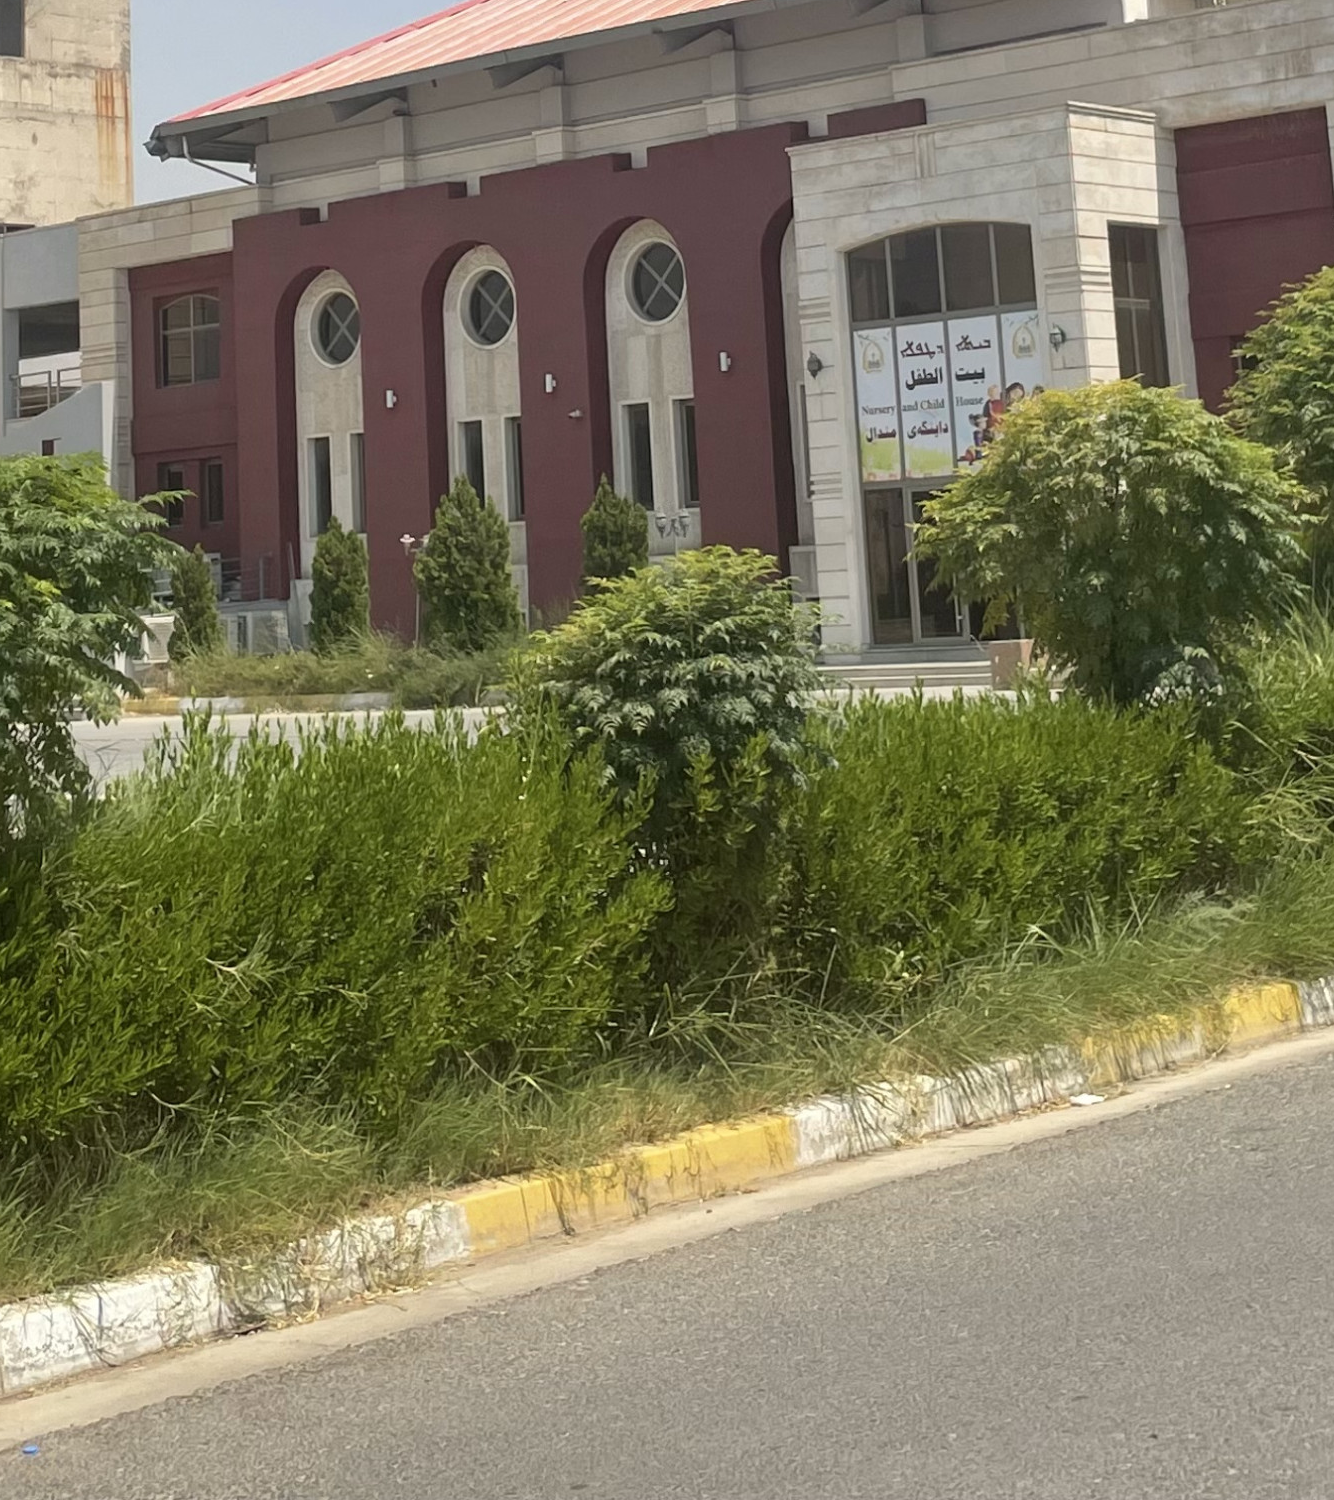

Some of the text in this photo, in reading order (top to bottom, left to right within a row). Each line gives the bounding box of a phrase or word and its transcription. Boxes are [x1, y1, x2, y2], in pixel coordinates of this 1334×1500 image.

[905, 366, 943, 390] الطفل
[955, 367, 986, 385] بيت
[862, 396, 984, 416] Nursery and Child House
